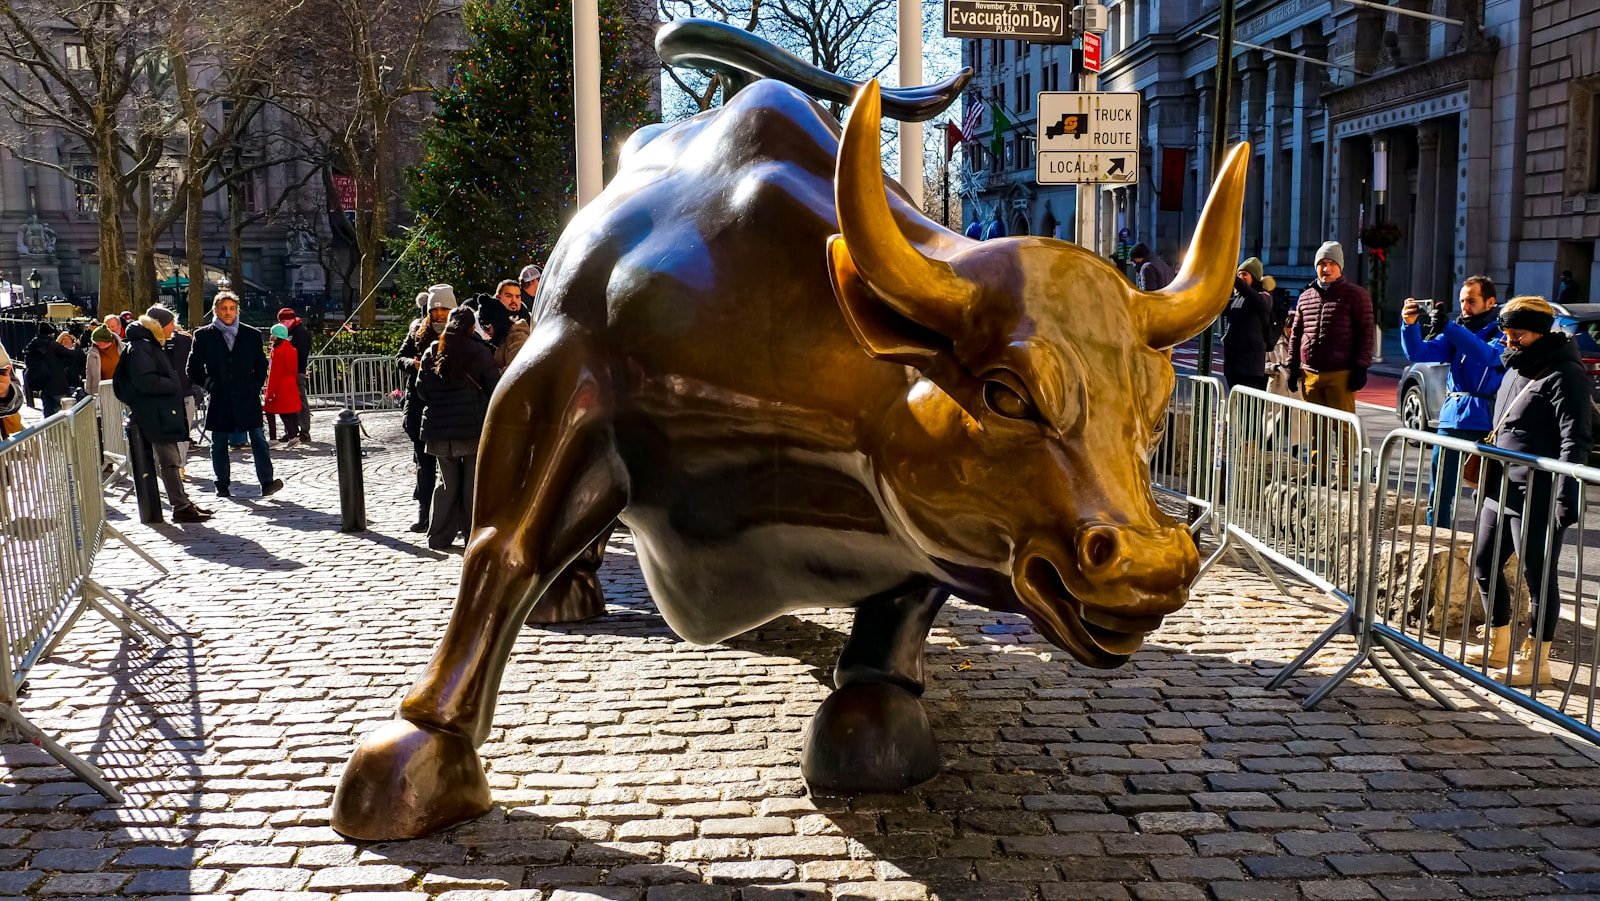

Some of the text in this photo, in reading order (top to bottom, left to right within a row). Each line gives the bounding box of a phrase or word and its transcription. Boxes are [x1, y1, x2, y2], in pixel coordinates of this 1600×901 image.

[951, 8, 1060, 32] Evacuation Day
[995, 25, 1016, 33] PLAZA
[1094, 109, 1132, 121] TRUCK
[1094, 132, 1132, 145] ROUTE
[1050, 161, 1089, 174] LOCAL
